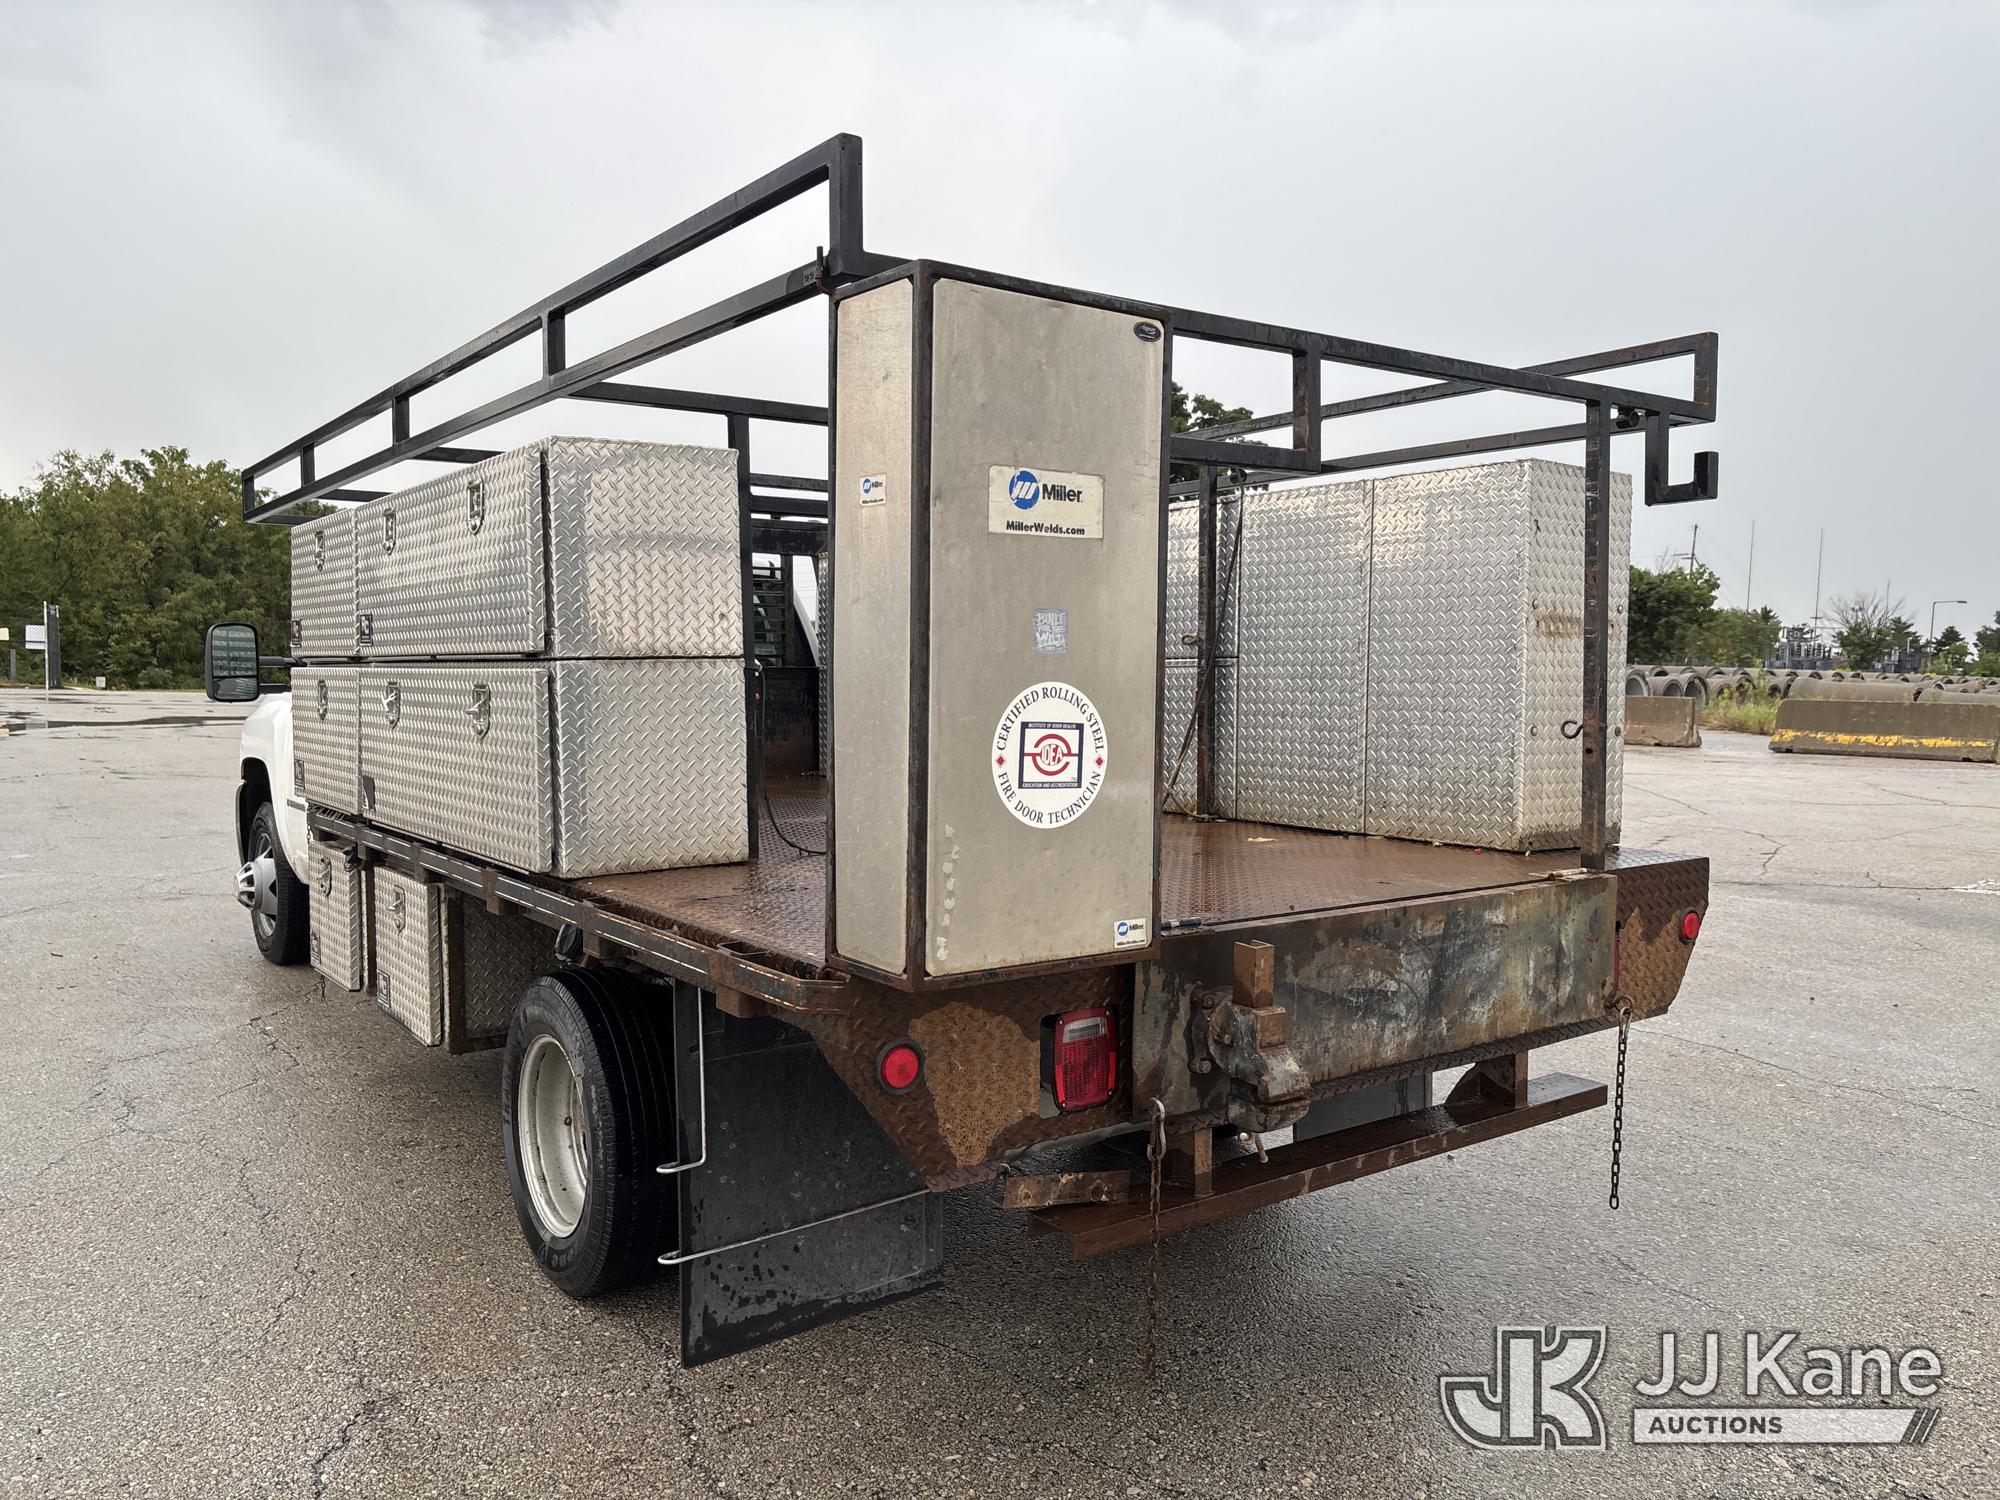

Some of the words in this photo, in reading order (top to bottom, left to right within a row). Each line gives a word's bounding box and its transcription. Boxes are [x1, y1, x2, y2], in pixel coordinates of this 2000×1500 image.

[1042, 483, 1082, 502] Miller
[1006, 520, 1085, 535] MillerWelds.com
[997, 690, 1039, 751] CERTIFIED
[1042, 687, 1089, 715] ROLLING
[1086, 712, 1104, 753] STEEL
[1041, 744, 1063, 766] IDEA
[998, 772, 1016, 802] FIRE
[1014, 800, 1043, 824] DOOR
[1048, 771, 1101, 824] TECHNICIAN
